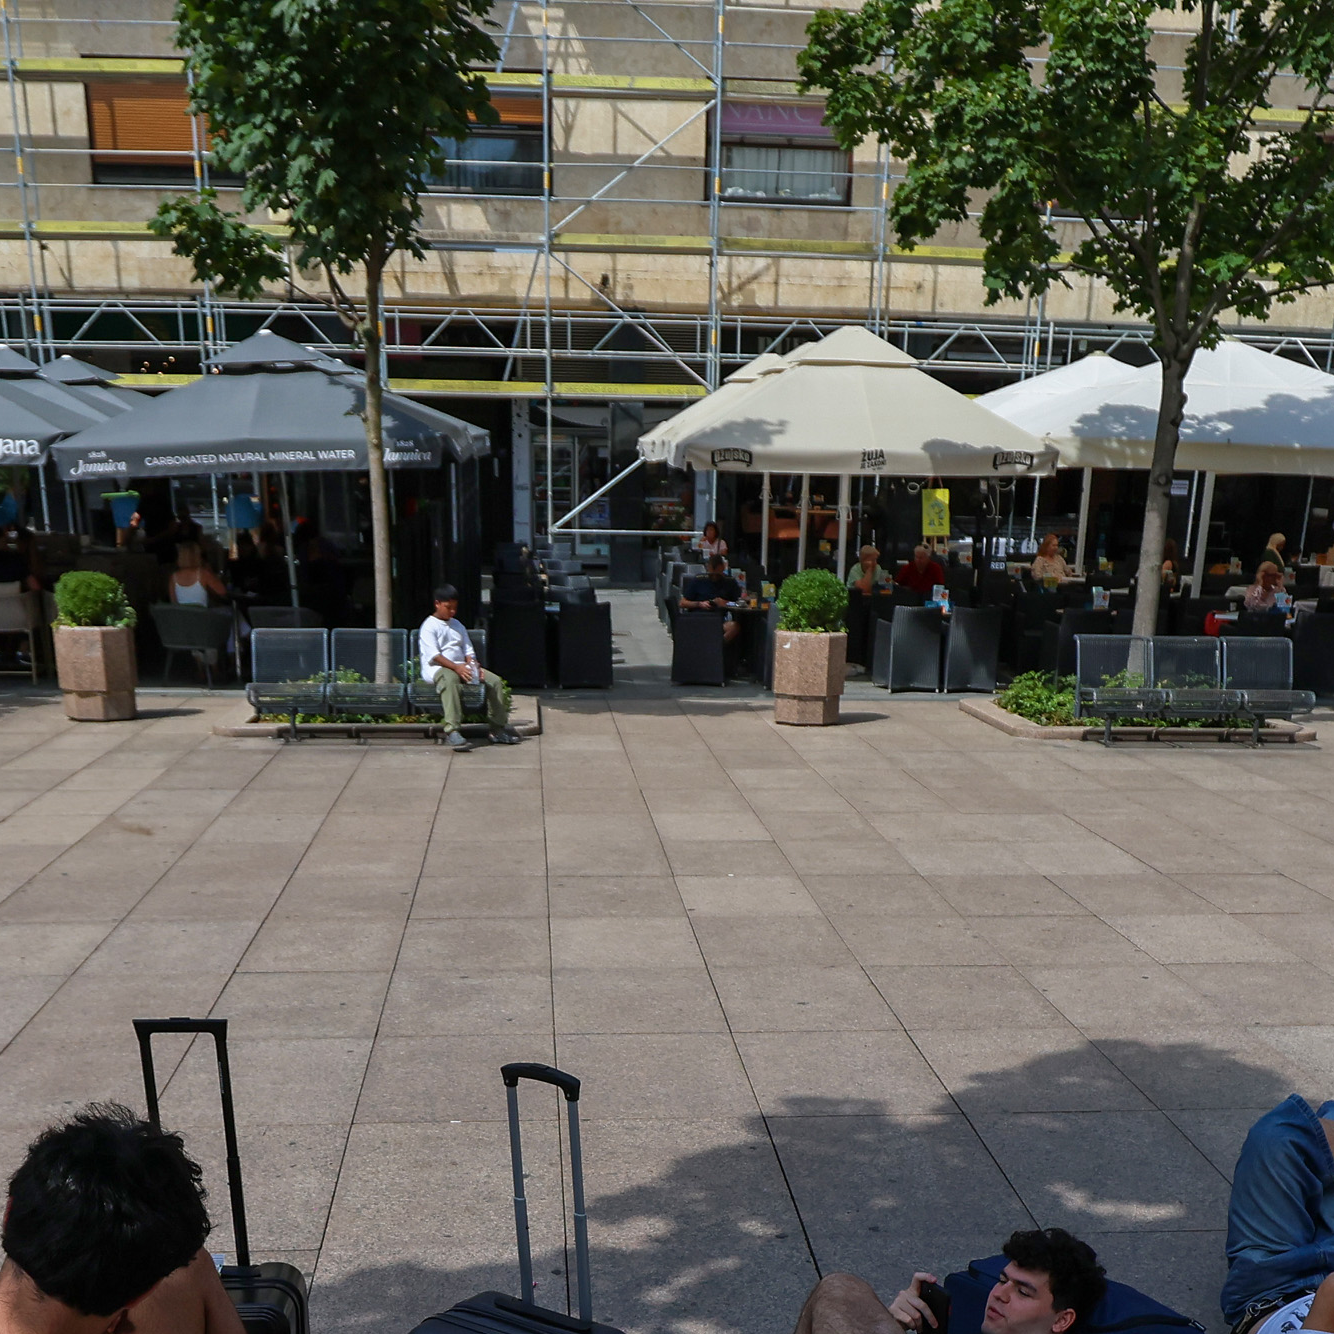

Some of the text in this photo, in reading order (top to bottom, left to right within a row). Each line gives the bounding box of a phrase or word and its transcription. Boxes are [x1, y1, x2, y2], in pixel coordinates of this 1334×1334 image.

[144, 449, 356, 466] CARBONATED NATURAL MINERAL WATER
[70, 458, 127, 475] Jamnica
